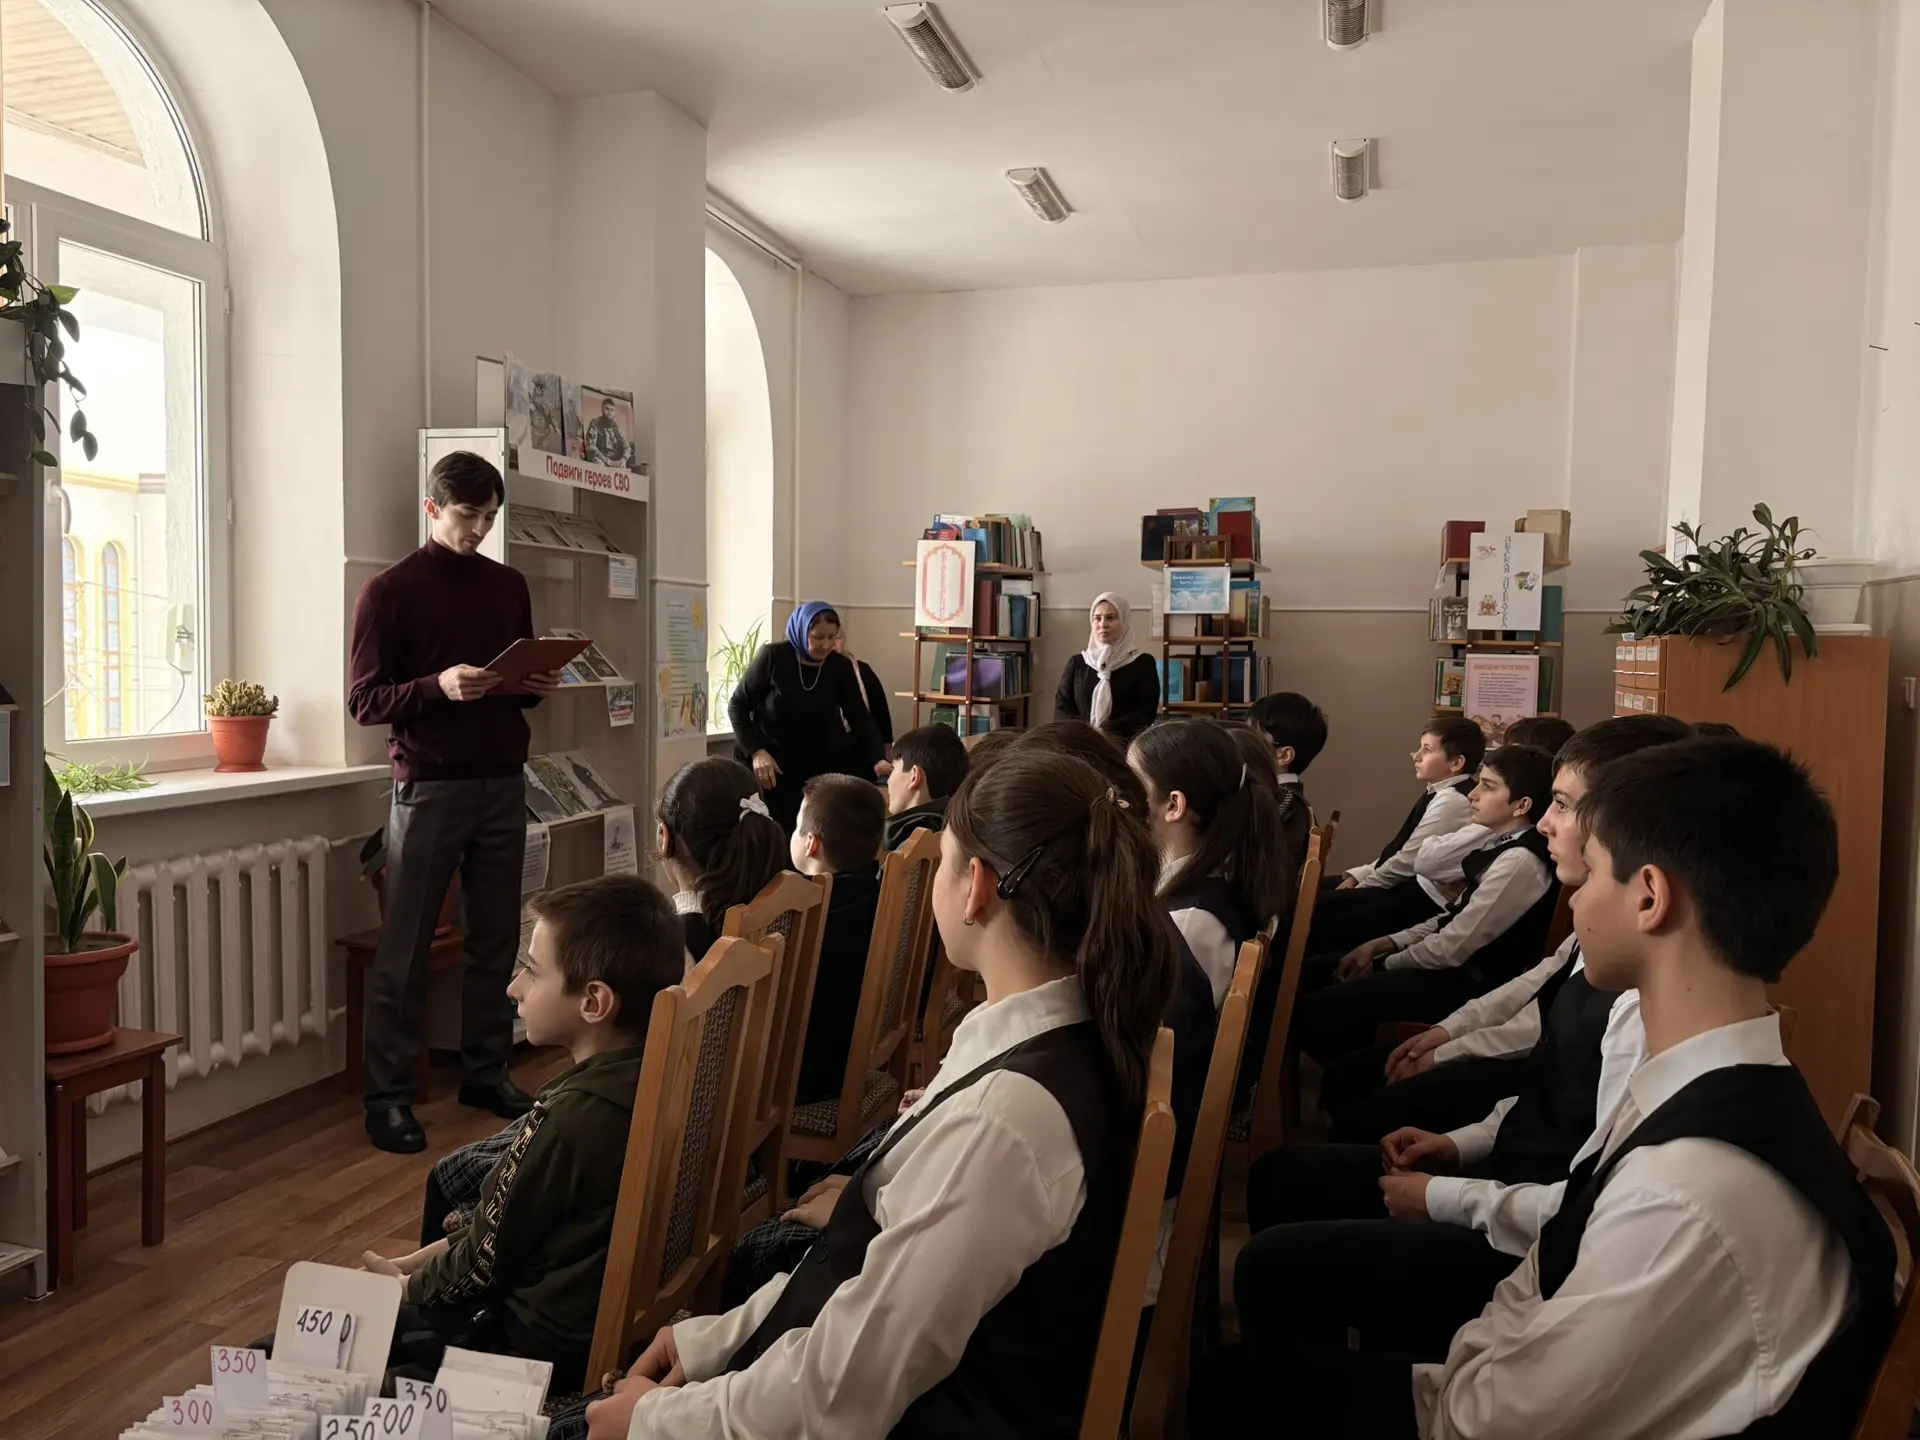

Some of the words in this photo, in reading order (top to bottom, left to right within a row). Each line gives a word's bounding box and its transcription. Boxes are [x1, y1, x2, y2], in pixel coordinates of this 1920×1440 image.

[546, 455, 582, 482] Подвиги
[585, 470, 612, 489] героев
[614, 472, 630, 492] СВО
[297, 1309, 332, 1335] 450
[218, 1349, 256, 1374] 350
[405, 1381, 447, 1413] 350
[172, 1400, 212, 1425] 300
[371, 1403, 414, 1435] 200
